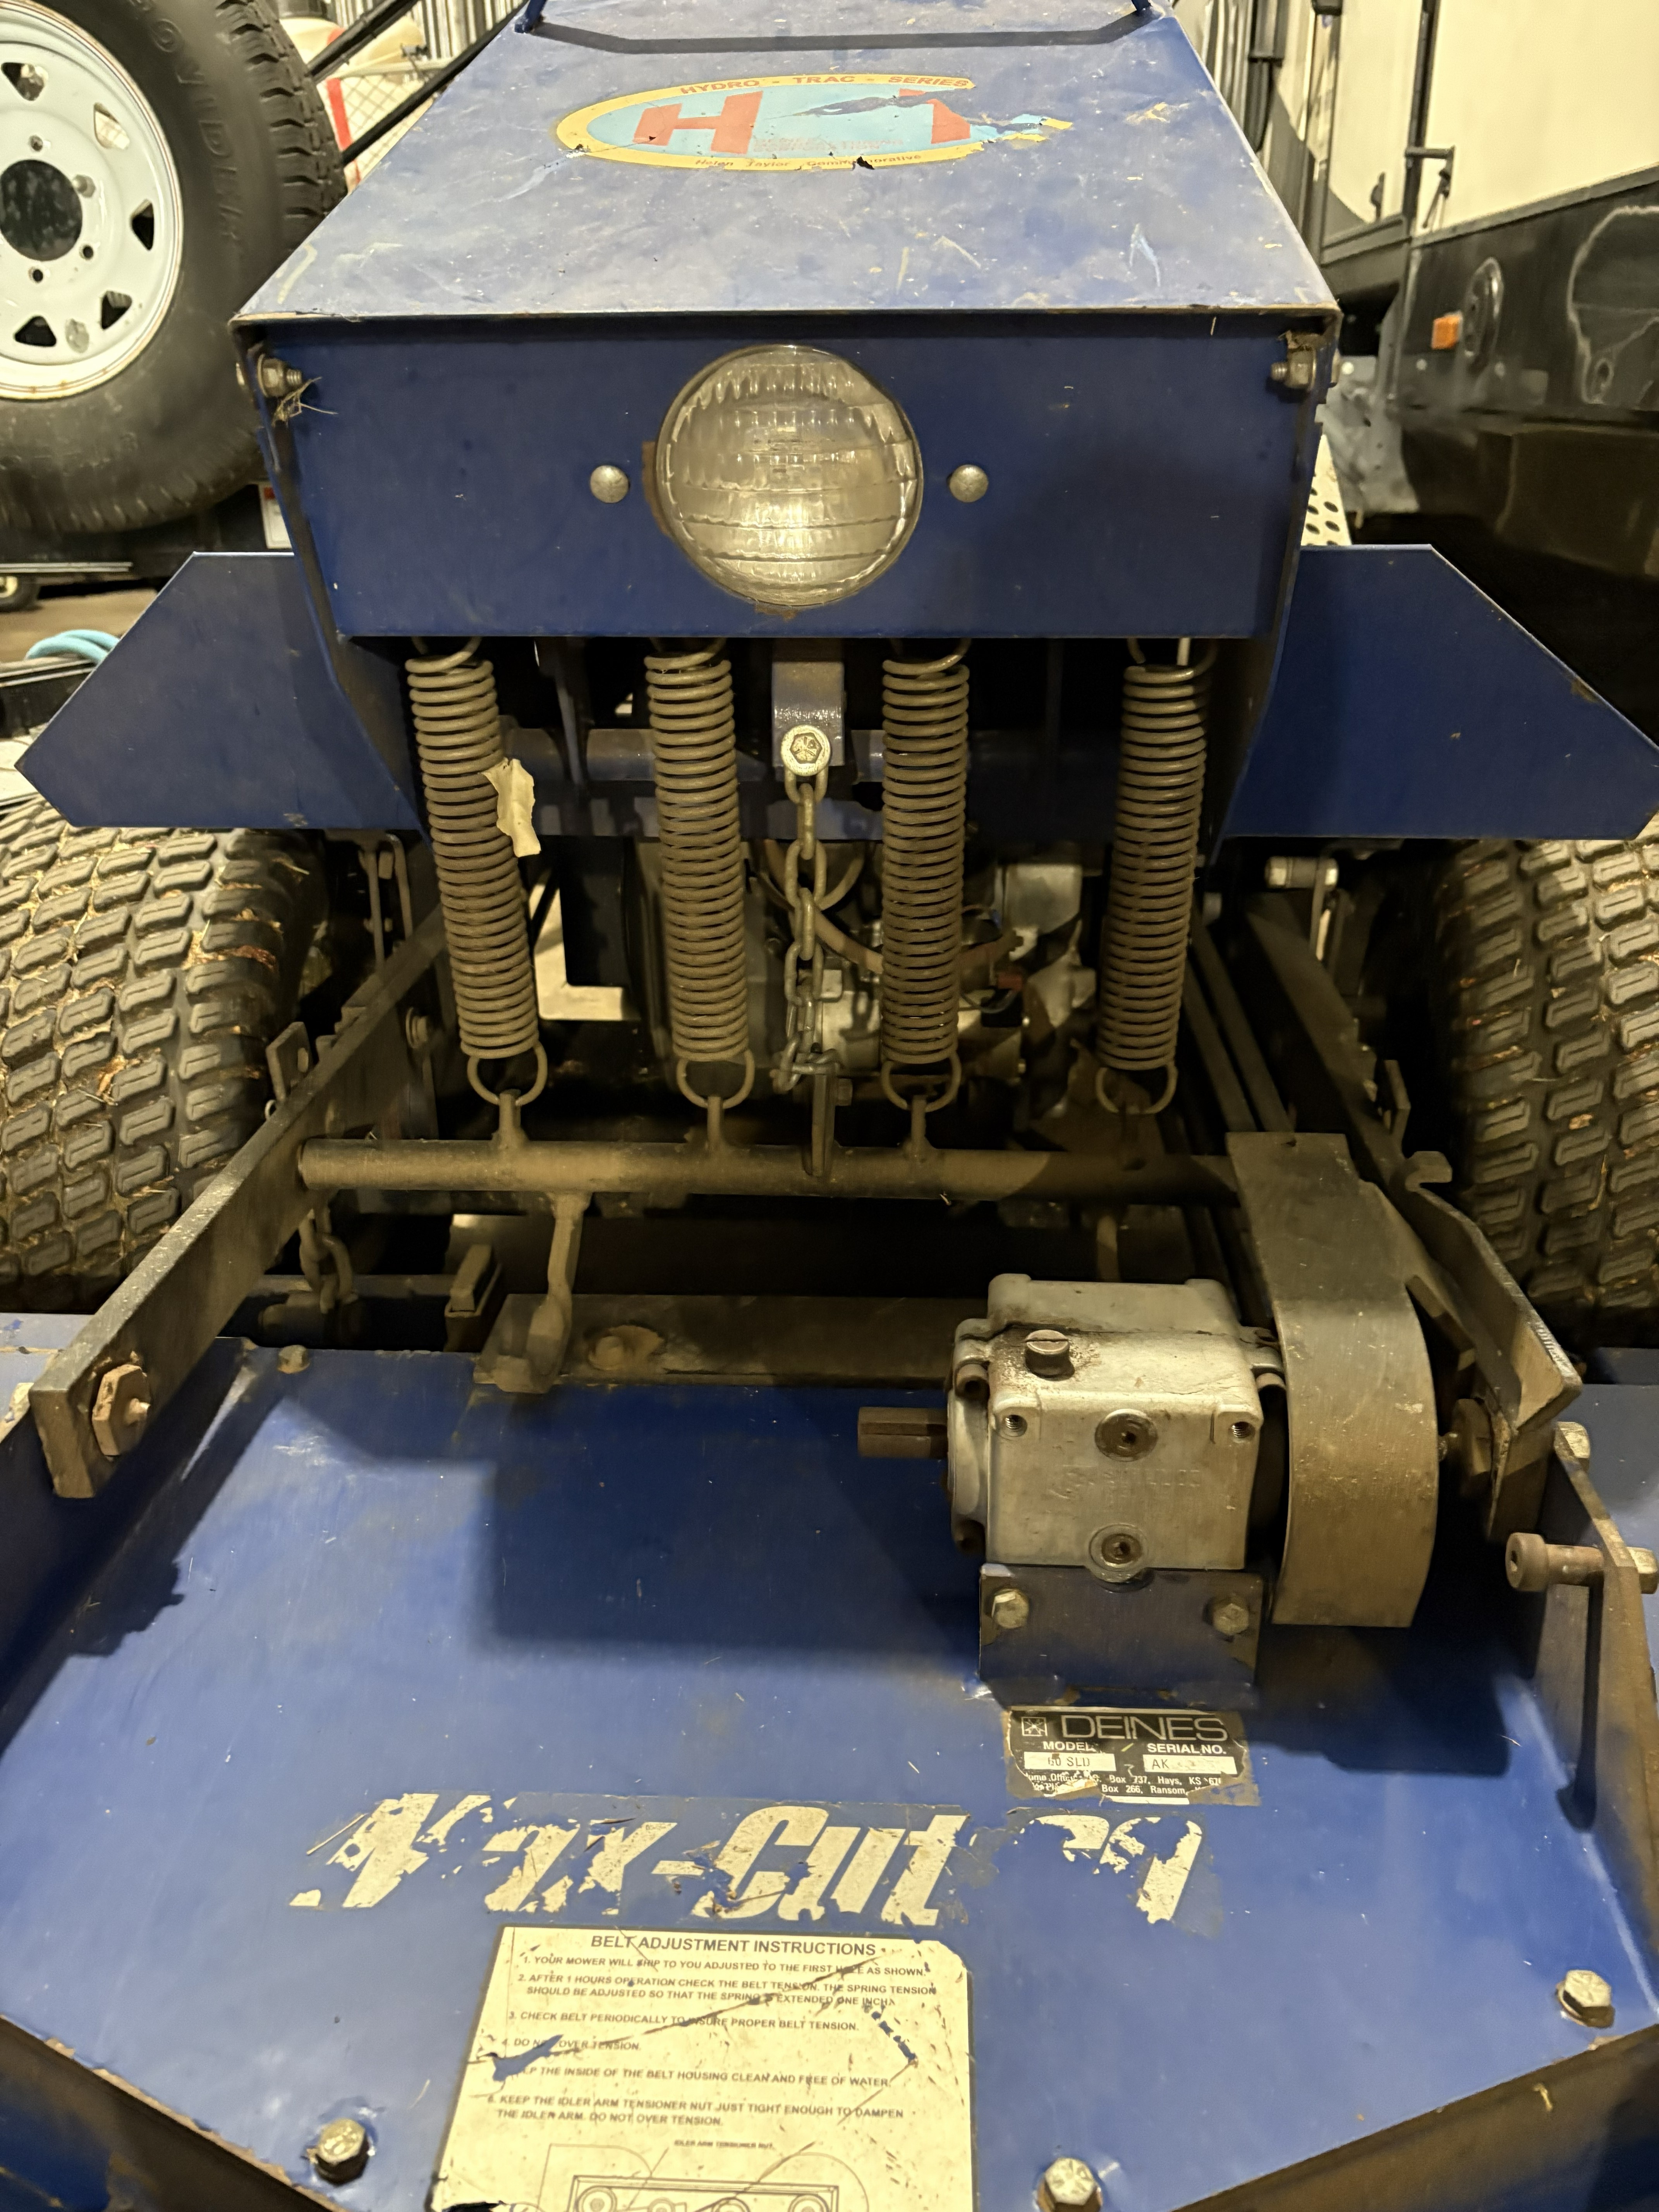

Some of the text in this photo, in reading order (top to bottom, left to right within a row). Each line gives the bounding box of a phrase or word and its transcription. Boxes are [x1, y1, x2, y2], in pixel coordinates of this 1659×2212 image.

[680, 80, 759, 94] HYDRO
[888, 76, 969, 87] SERIES
[1061, 1715, 1228, 1741] DEINES
[1042, 1741, 1096, 1751] MODEL
[1147, 1743, 1227, 1754] SERIAL NO.
[1066, 1757, 1091, 1767] SLD
[1152, 1759, 1170, 1770] AK
[1101, 1784, 1119, 1793] Box
[1109, 1774, 1126, 1783] Box
[1189, 1776, 1202, 1785] KS
[591, 1936, 876, 1956] BELT ADJUSTMENT INSTRUCTIONS
[534, 1956, 563, 1965] YOUR
[565, 1957, 606, 1966] MOWER
[609, 1958, 634, 1967] WILL
[663, 1960, 677, 1968] TO
[680, 1961, 702, 1969] YOU
[703, 1961, 760, 1971] ADJUSTED
[762, 1963, 776, 1971] TO
[779, 1964, 800, 1972] THE
[802, 1964, 833, 1973] FIRST
[866, 1966, 881, 1975] AS
[884, 1967, 926, 1976] SHOWN.
[528, 1975, 564, 1983] AFTER
[574, 1976, 612, 1984] HOURS
[614, 1977, 676, 1987] OPERATION
[677, 1979, 715, 1988] CHECK
[718, 1980, 738, 1989] THE
[741, 1981, 768, 1989] BELT
[823, 1984, 844, 1992] THE
[847, 1984, 887, 1993] SPRING
[890, 1985, 936, 1995] TENSION
[526, 1986, 570, 1995] SHOULD
[589, 1988, 646, 1998] ADJUSTED
[648, 1990, 664, 1998] SO
[667, 1991, 694, 1999] THAT
[697, 1992, 717, 2000] THE
[776, 1994, 833, 2004] EXTENDED
[836, 1996, 859, 2005] ONE
[520, 2012, 558, 2021] CHECK
[560, 2013, 587, 2021] BELT
[590, 2014, 667, 2024] PERIODICALLY
[730, 2018, 776, 2027] PROPER
[778, 2020, 806, 2028] BELT
[809, 2020, 859, 2030] TENSION.
[514, 2038, 530, 2046] DO
[558, 2039, 589, 2048] OVER
[541, 2068, 561, 2076] THE
[563, 2068, 601, 2077] INSIDE
[603, 2069, 618, 2078] OF
[623, 2070, 644, 2079] THE
[646, 2071, 675, 2080] BELT
[677, 2072, 728, 2081] HOUSING
[731, 2074, 769, 2083] CLEAN
[772, 2075, 796, 2084] AND
[798, 2076, 828, 2085] FREE
[831, 2077, 846, 2085] OF
[849, 2078, 890, 2087] WATER.
[500, 2095, 531, 2105] KEEP
[533, 2096, 555, 2106] THE
[558, 2097, 591, 2107] IDLER
[593, 2098, 620, 2108] ARM
[623, 2099, 687, 2110] TENSIONER
[690, 2102, 713, 2111] NUT
[714, 2103, 745, 2112] JUST
[747, 2104, 781, 2114] TIGHT
[784, 2105, 833, 2116] ENOUGH
[836, 2107, 852, 2116] TO
[854, 2108, 903, 2118] DAMPEN
[497, 2109, 518, 2118] THE
[589, 2112, 607, 2121] DO
[609, 2113, 632, 2123] NOT
[636, 2114, 668, 2124] OVER
